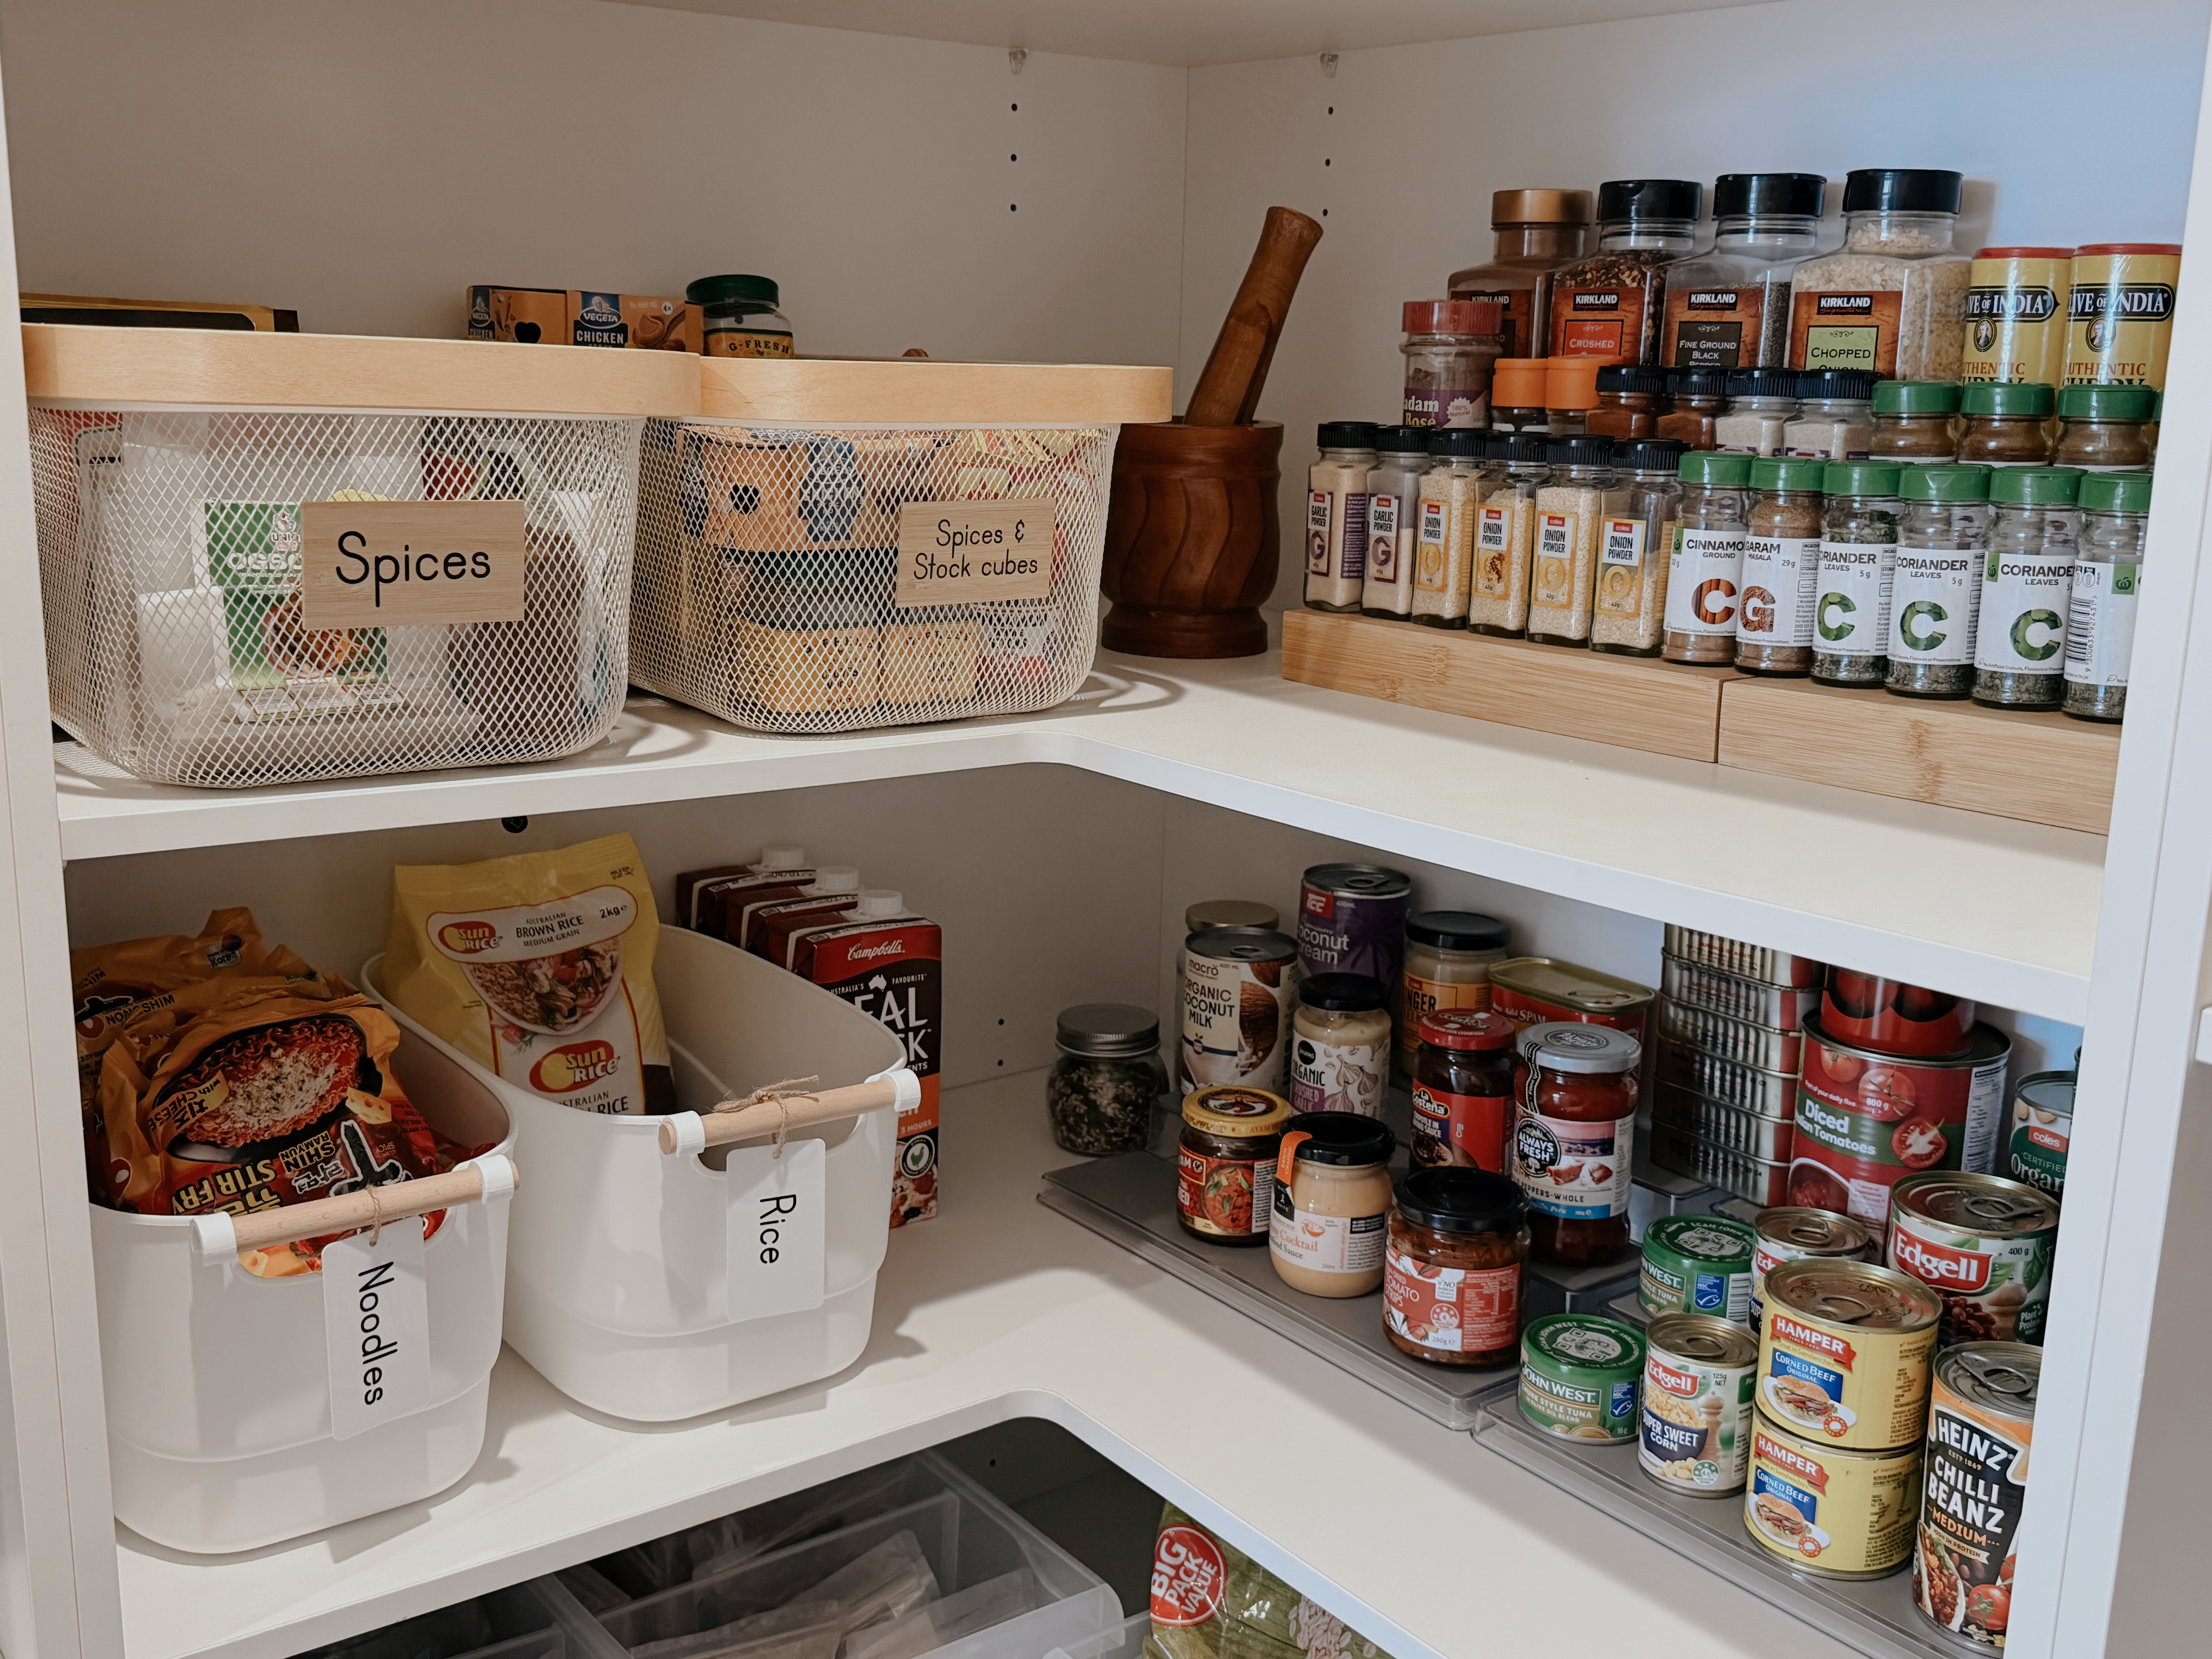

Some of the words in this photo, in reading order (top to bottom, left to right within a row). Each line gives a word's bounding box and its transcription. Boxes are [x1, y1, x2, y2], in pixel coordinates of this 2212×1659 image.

[1472, 294, 1510, 306] KIRKLAND
[1575, 294, 1618, 306] KIRKLAND
[1690, 293, 1736, 305] KIRKLAND
[1820, 297, 1871, 309] KIRKLAND
[1981, 296, 1991, 309] OF
[1993, 295, 2045, 314] INDIA
[2096, 296, 2108, 309] OF
[583, 313, 618, 323] VEGETA
[576, 330, 624, 344] CHICKEN
[1569, 338, 1615, 350] CRUSHED
[1679, 340, 1698, 350] FINE
[1700, 340, 1737, 350] GROUND
[728, 339, 790, 354] G-FRESH
[1692, 351, 1720, 360] BLACK
[1811, 348, 1871, 360] CHOPPED
[1311, 505, 1327, 518] GARLIC
[1374, 509, 1394, 522] GARLIC
[1311, 517, 1326, 528] POWDER
[1374, 522, 1393, 533] POWDER
[1425, 517, 1441, 529] ONION
[1483, 522, 1503, 535] ONION
[935, 519, 1003, 558] Spices
[1424, 529, 1441, 539] POWDER
[1482, 534, 1503, 546] POWDER
[1544, 529, 1566, 542] ONION
[1609, 536, 1633, 549] ONION
[1543, 542, 1566, 553] POWDER
[1686, 539, 1745, 551] CINNAMO
[1745, 541, 1781, 554] GARAM
[1608, 549, 1633, 561] POWDER
[1748, 553, 1772, 562] MASALA
[1820, 551, 1876, 565] ORIANDER
[1896, 556, 1968, 572] CORIANDER
[336, 531, 491, 608] Spices
[913, 552, 970, 581] Stock
[981, 548, 1038, 577] cubes
[1824, 563, 1850, 572] LEAVES
[2001, 563, 2075, 577] CORIANDE
[1910, 571, 1942, 579] LEAVES
[1951, 577, 1956, 585] 5
[2025, 578, 2059, 586] LEAVES
[1691, 578, 1737, 625] C
[1740, 586, 1776, 633] G
[1817, 592, 1857, 642] C
[1899, 600, 1948, 651] C
[2009, 608, 2063, 661] C
[526, 912, 567, 925] AUSTRALIAN
[599, 907, 620, 919] 2kg
[515, 923, 555, 938] BROWN
[558, 915, 585, 931] RICE
[523, 936, 554, 947] MEDIUM
[556, 929, 580, 941] GRAIN
[1298, 924, 1350, 951] oconut
[847, 939, 902, 961] Campbell's
[1188, 958, 1219, 976] macro
[892, 974, 925, 985] FAVOURITE
[142, 994, 175, 1013] SHIM
[1403, 987, 1437, 1013] INGER
[1189, 1008, 1212, 1029] MILK
[1519, 1009, 1546, 1024] SPAM
[1421, 1090, 1429, 1101] La
[1817, 1087, 1829, 1099] your
[1829, 1092, 1844, 1104] daily
[1843, 1097, 1856, 1108] five
[1866, 1098, 1881, 1108] 800
[1883, 1102, 1889, 1111] g
[597, 1096, 629, 1115] RICE
[907, 1119, 932, 1132] HOURS
[1805, 1099, 1850, 1134] Diced
[278, 1131, 330, 1161] RAMYUN
[1519, 1131, 1555, 1152] ALWAYS
[1814, 1123, 1877, 1156] Tomatoes
[2033, 1132, 2060, 1147] coles
[280, 1142, 335, 1173] SHIN
[1519, 1142, 1550, 1162] FRESH
[215, 1159, 277, 1195] STIR
[171, 1180, 214, 1212] FRY
[759, 1194, 797, 1264] Rice
[1279, 1229, 1319, 1252] Cocktail
[1283, 1244, 1304, 1259] Sauce
[1896, 1235, 1980, 1283] Edgell
[2008, 1247, 2024, 1256] 400
[2025, 1249, 2030, 1257] g
[1648, 1262, 1681, 1288] WEST
[1657, 1286, 1677, 1304] TUNA
[358, 1261, 398, 1406] Noodles
[1432, 1336, 1447, 1346] 280g
[1776, 1317, 1845, 1355] HAMPER
[1798, 1348, 1835, 1368] Sandwiches
[1522, 1364, 1549, 1392] JOHN
[1550, 1382, 1596, 1404] WEST
[1649, 1359, 1692, 1391] Edgell
[1530, 1398, 1545, 1412] OLIVE
[1546, 1407, 1557, 1417] OIL
[1558, 1413, 1580, 1423] BLEND
[1539, 1397, 1564, 1413] STYLE
[1567, 1407, 1593, 1419] TUNA
[1644, 1409, 1662, 1432] SUPER
[1664, 1424, 1698, 1447] SWEET
[1650, 1432, 1678, 1452] CORN
[1937, 1417, 2009, 1471] HEINZ
[1759, 1435, 1817, 1477] HAMPER
[1965, 1458, 1982, 1471] 1869
[1935, 1455, 2000, 1505] CHILLI
[1928, 1472, 2005, 1535] BEANZ
[1932, 1509, 1987, 1547] MEDIUM
[1933, 1528, 1945, 1540] HIGH
[1953, 1540, 1980, 1558] PROTEIN
[1151, 1538, 1188, 1596] BIG
[1164, 1551, 1204, 1607] PACK
[1181, 1559, 1218, 1615] VALUE
